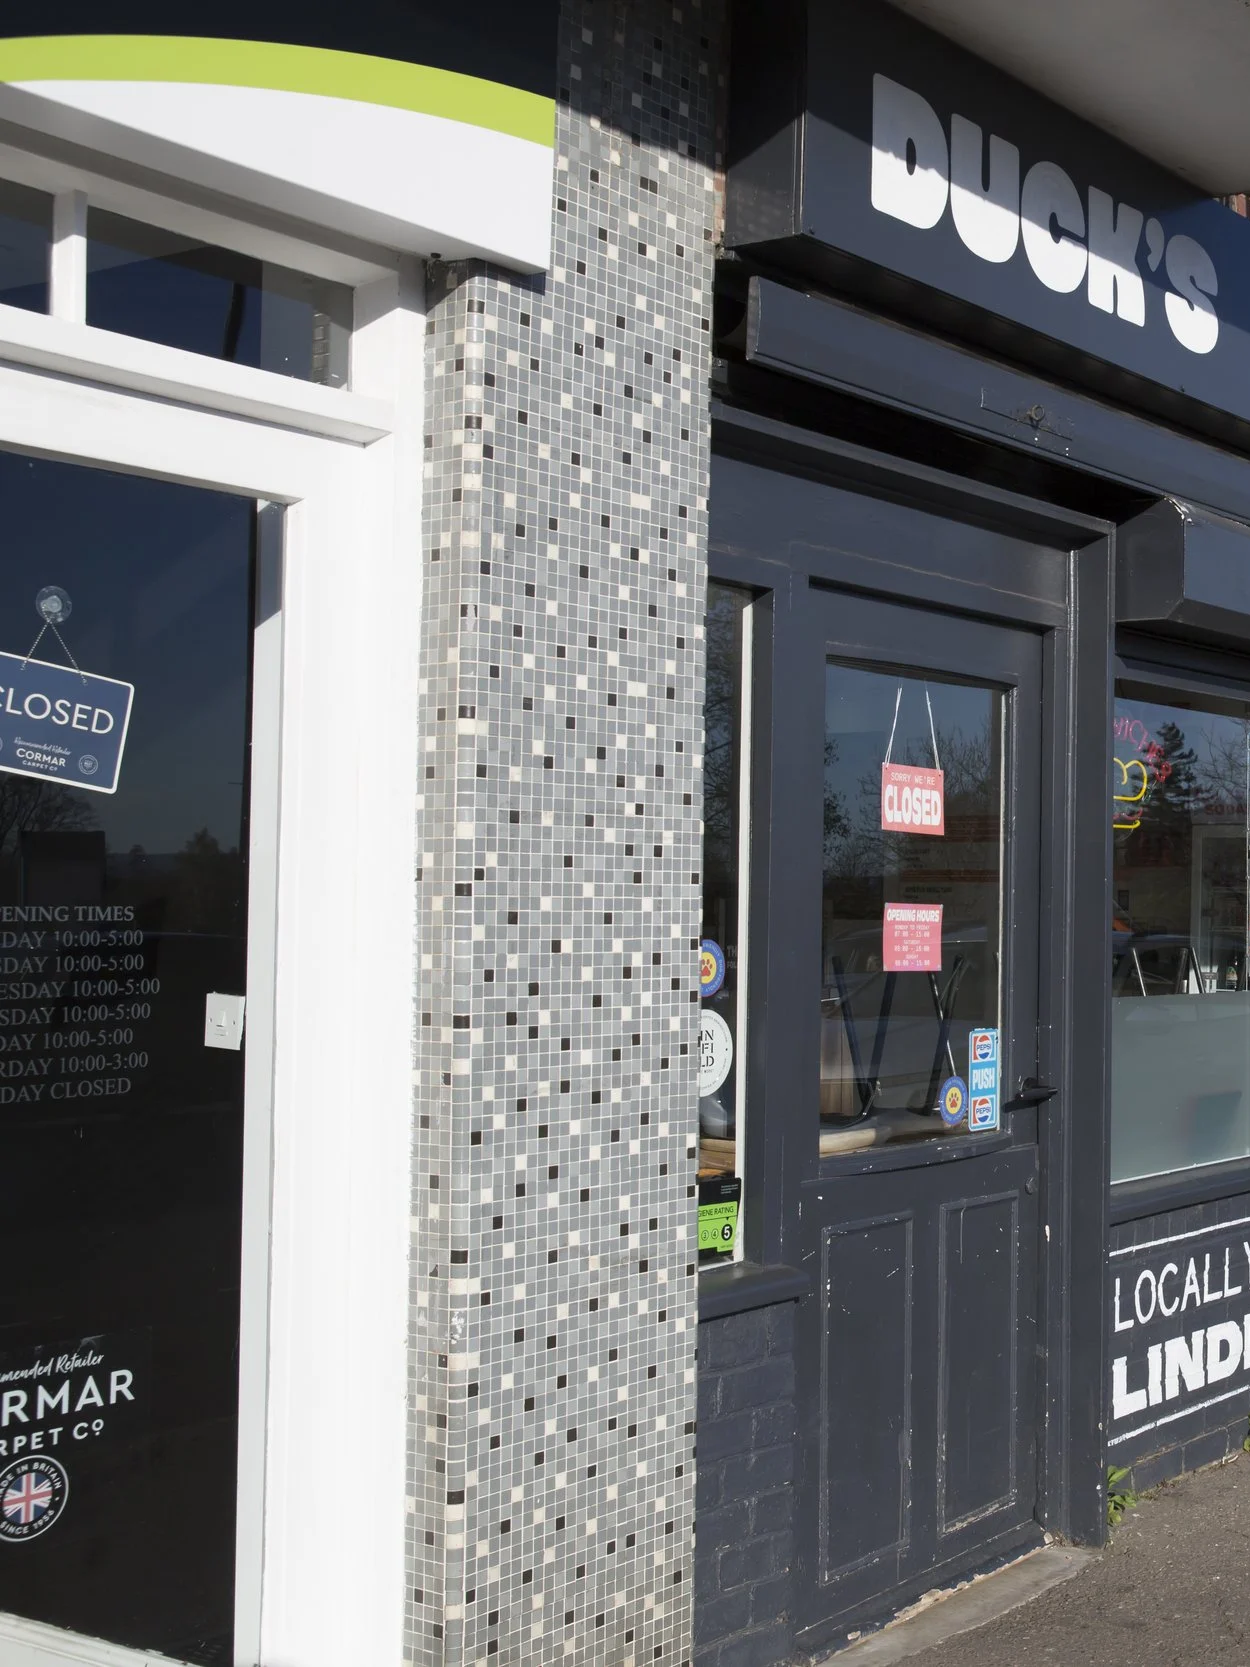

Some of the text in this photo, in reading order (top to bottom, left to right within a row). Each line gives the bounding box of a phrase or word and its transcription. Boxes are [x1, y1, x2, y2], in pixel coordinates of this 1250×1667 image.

[870, 72, 1219, 354] DUCK'S
[0, 686, 115, 735] LOSED
[16, 748, 66, 767] CORMAR
[21, 759, 49, 770] CARPET
[890, 771, 936, 786] SORRY WE'RE
[884, 783, 942, 826] CLOSED
[0, 905, 135, 922] ENING TIMES
[886, 908, 940, 923] OPENING HOURS
[53, 929, 144, 948] 10:00-5:00
[0, 953, 145, 975] DAY 10:00-5:00
[71, 977, 161, 997] 10:00-5:00
[62, 1002, 151, 1023] 10:00-5:00
[43, 1027, 134, 1049] 10:00-5:00
[976, 1043, 992, 1052] PEPSI
[59, 1051, 149, 1074] 10:00-3:00
[972, 1067, 995, 1091] PUSH
[0, 1077, 132, 1104] DAY CLOSED
[976, 1106, 992, 1115] PEPSI
[714, 1206, 734, 1215] RATING
[0, 1349, 104, 1384] mended Retailer
[0, 1369, 135, 1428] RMAR
[32, 1461, 63, 1491] BRITAIN
